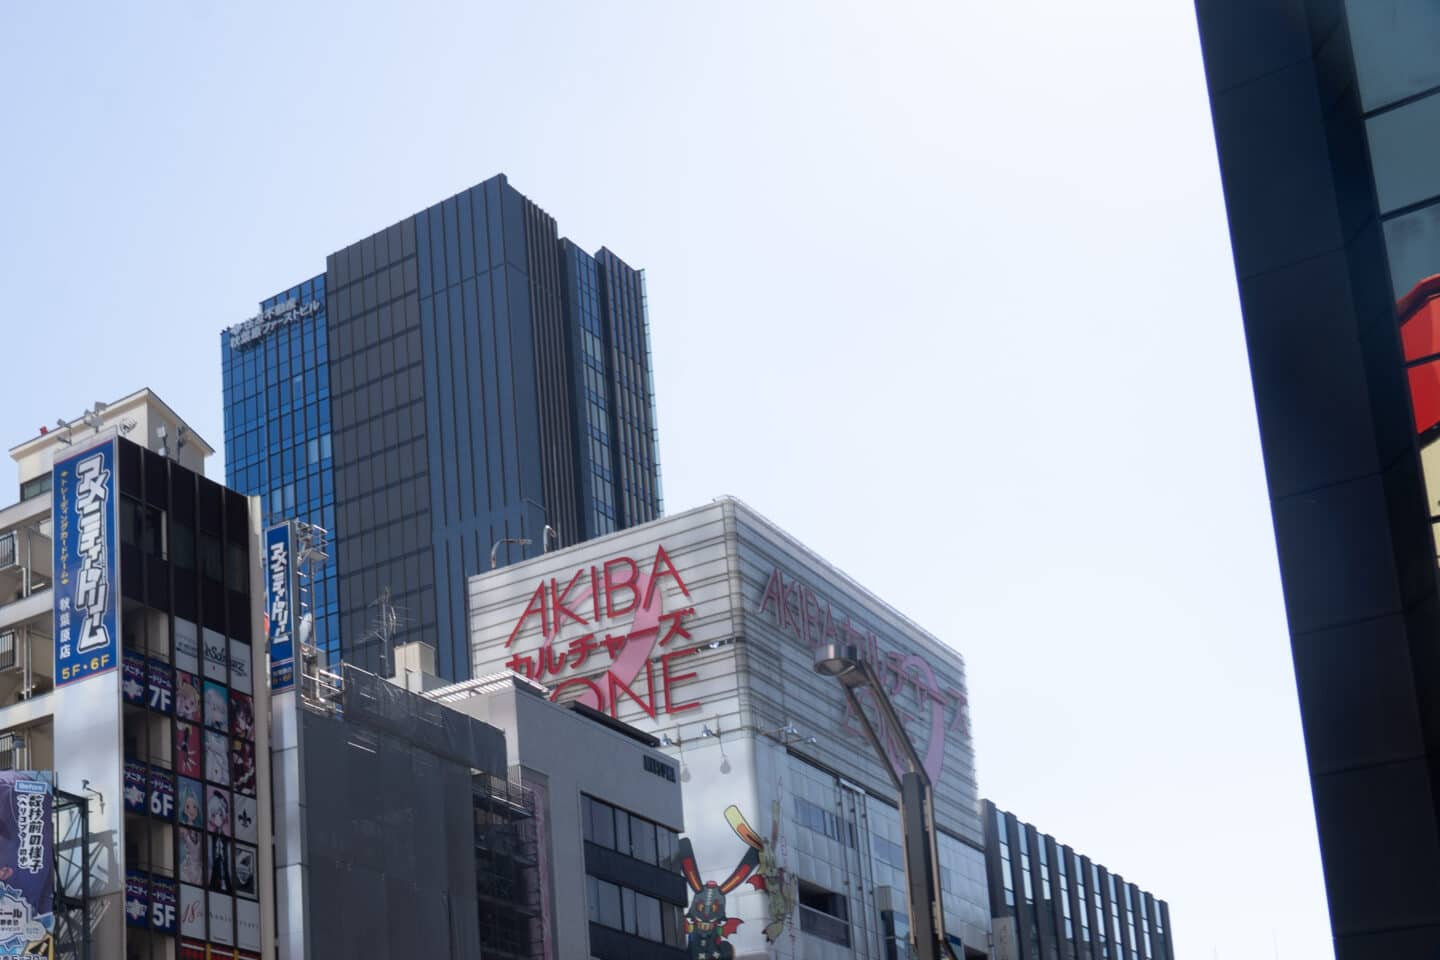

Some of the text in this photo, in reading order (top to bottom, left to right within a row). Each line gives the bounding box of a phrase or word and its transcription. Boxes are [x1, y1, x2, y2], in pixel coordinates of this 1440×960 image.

[503, 543, 692, 648] AKIBA
[59, 597, 71, 659] 秋葉原店
[505, 607, 697, 682] カルチャーズ
[148, 685, 171, 710] 7F
[550, 649, 700, 719] ONE
[150, 791, 173, 816] 6F
[152, 904, 175, 928] 5F
